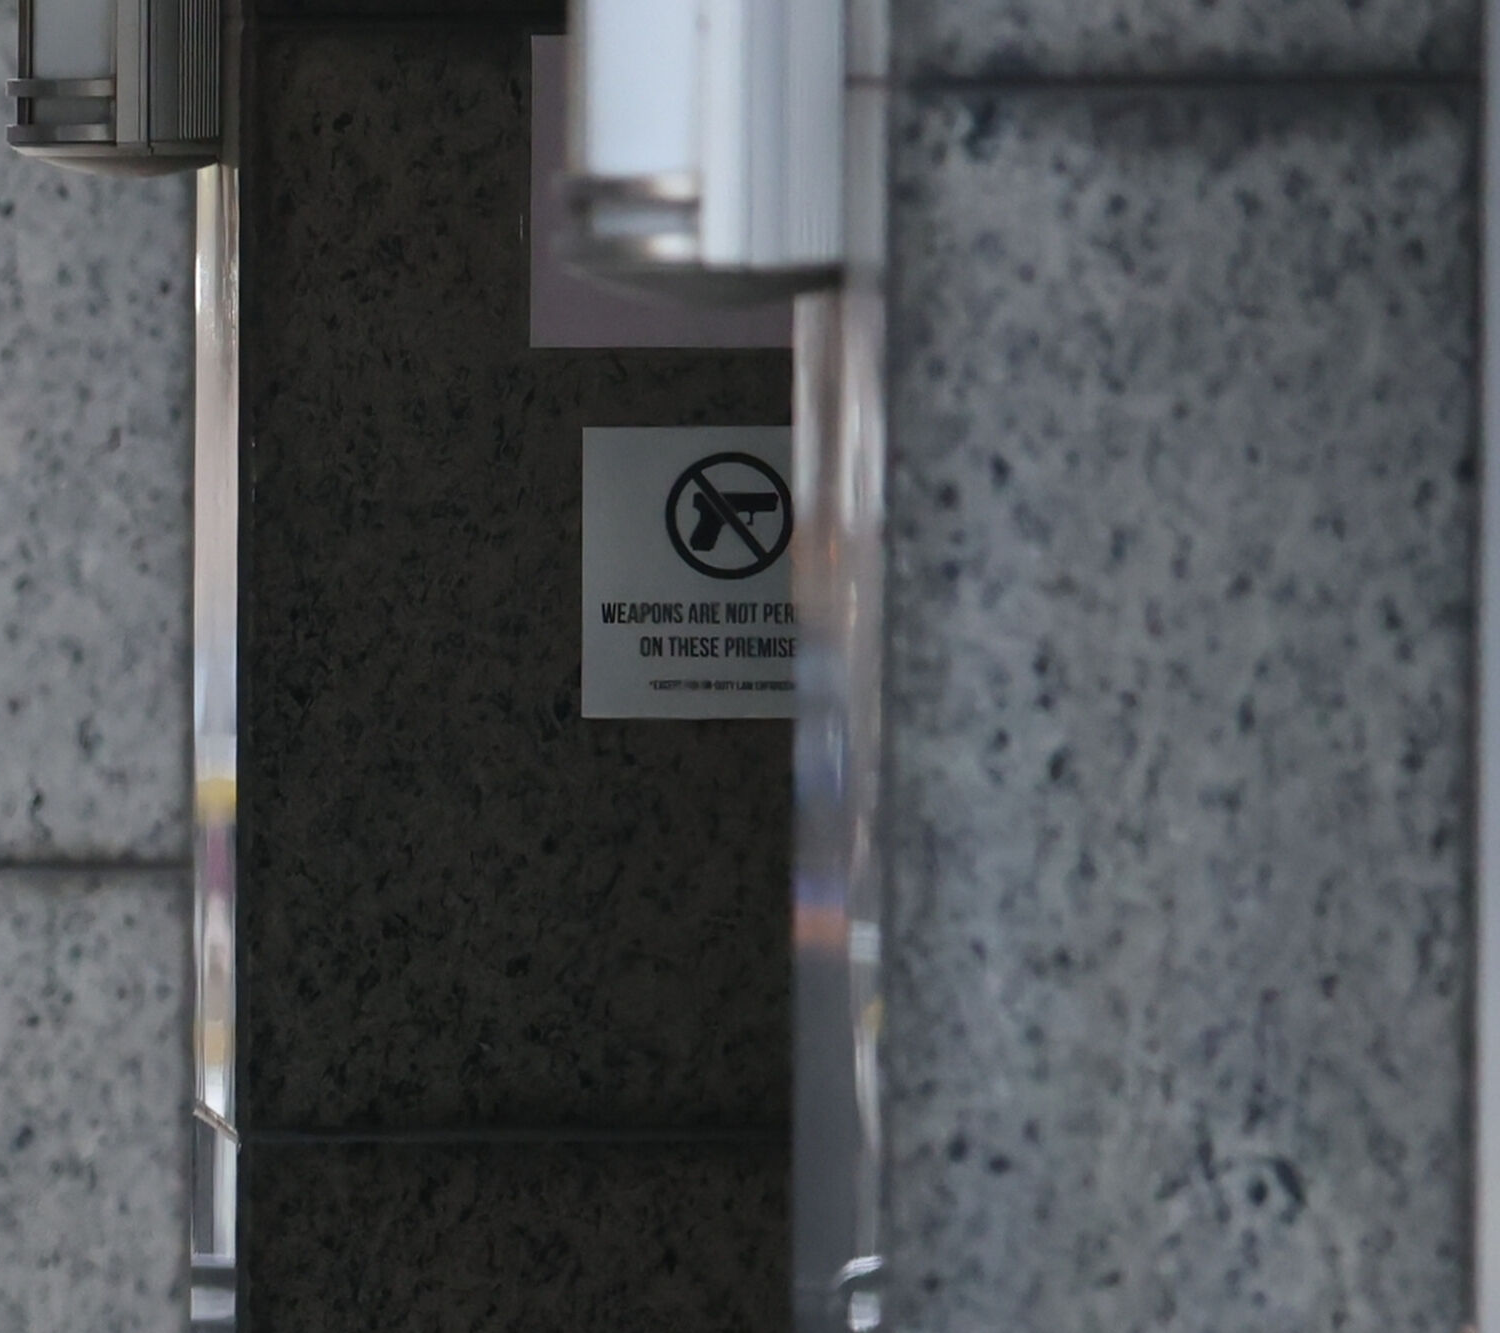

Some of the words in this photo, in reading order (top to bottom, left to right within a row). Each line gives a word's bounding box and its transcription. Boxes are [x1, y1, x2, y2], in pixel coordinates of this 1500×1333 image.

[602, 602, 683, 625] WEAPONS
[688, 602, 720, 625] ARE
[725, 602, 758, 625] NOT
[640, 636, 663, 657] ON
[668, 636, 720, 658] THESE
